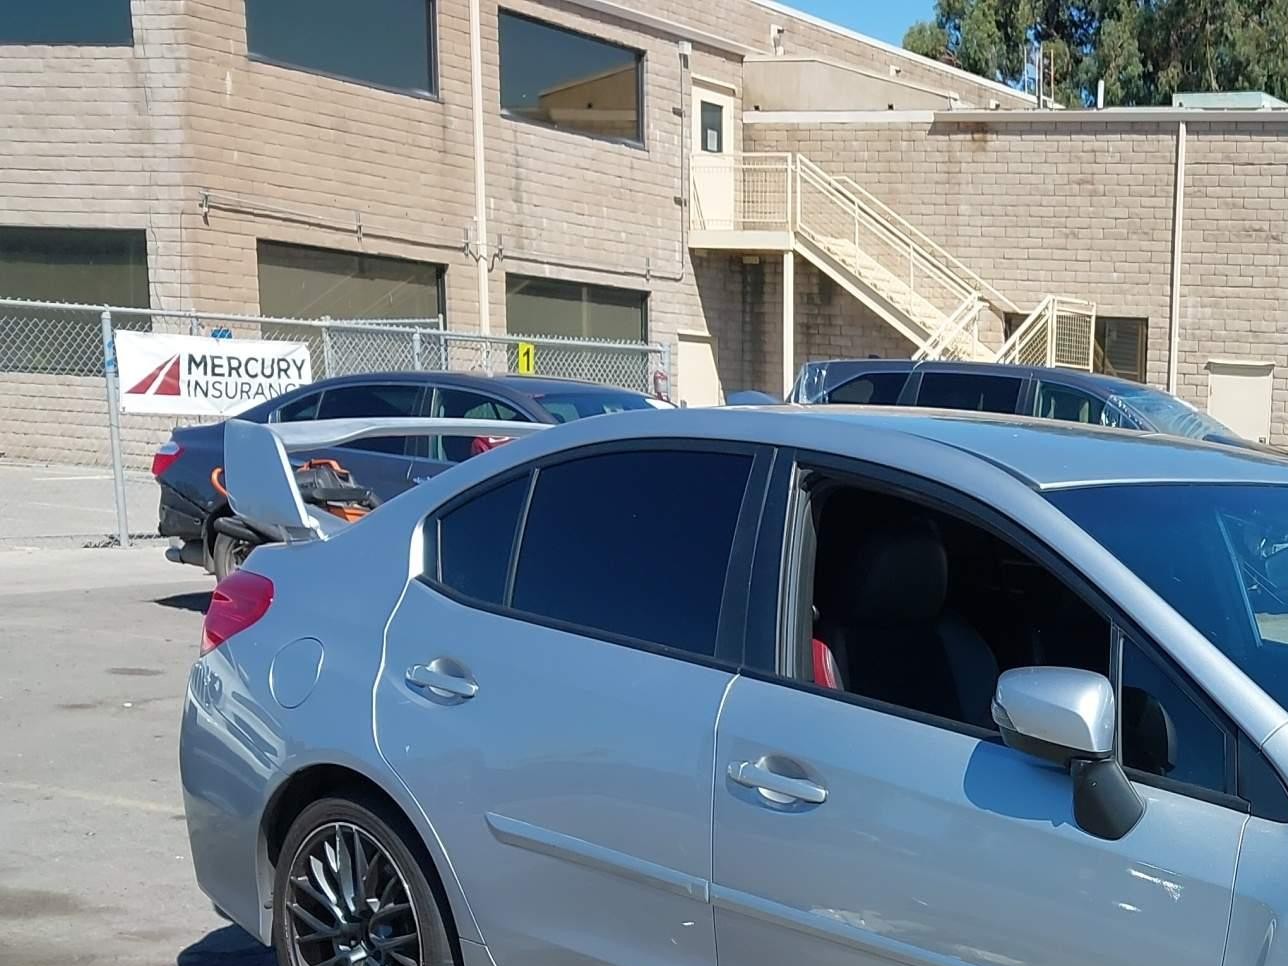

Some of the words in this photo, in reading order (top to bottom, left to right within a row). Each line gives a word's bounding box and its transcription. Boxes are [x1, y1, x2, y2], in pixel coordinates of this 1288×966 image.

[187, 353, 305, 380] MERCURY
[522, 347, 531, 372] 1
[187, 379, 301, 400] INSURANC
